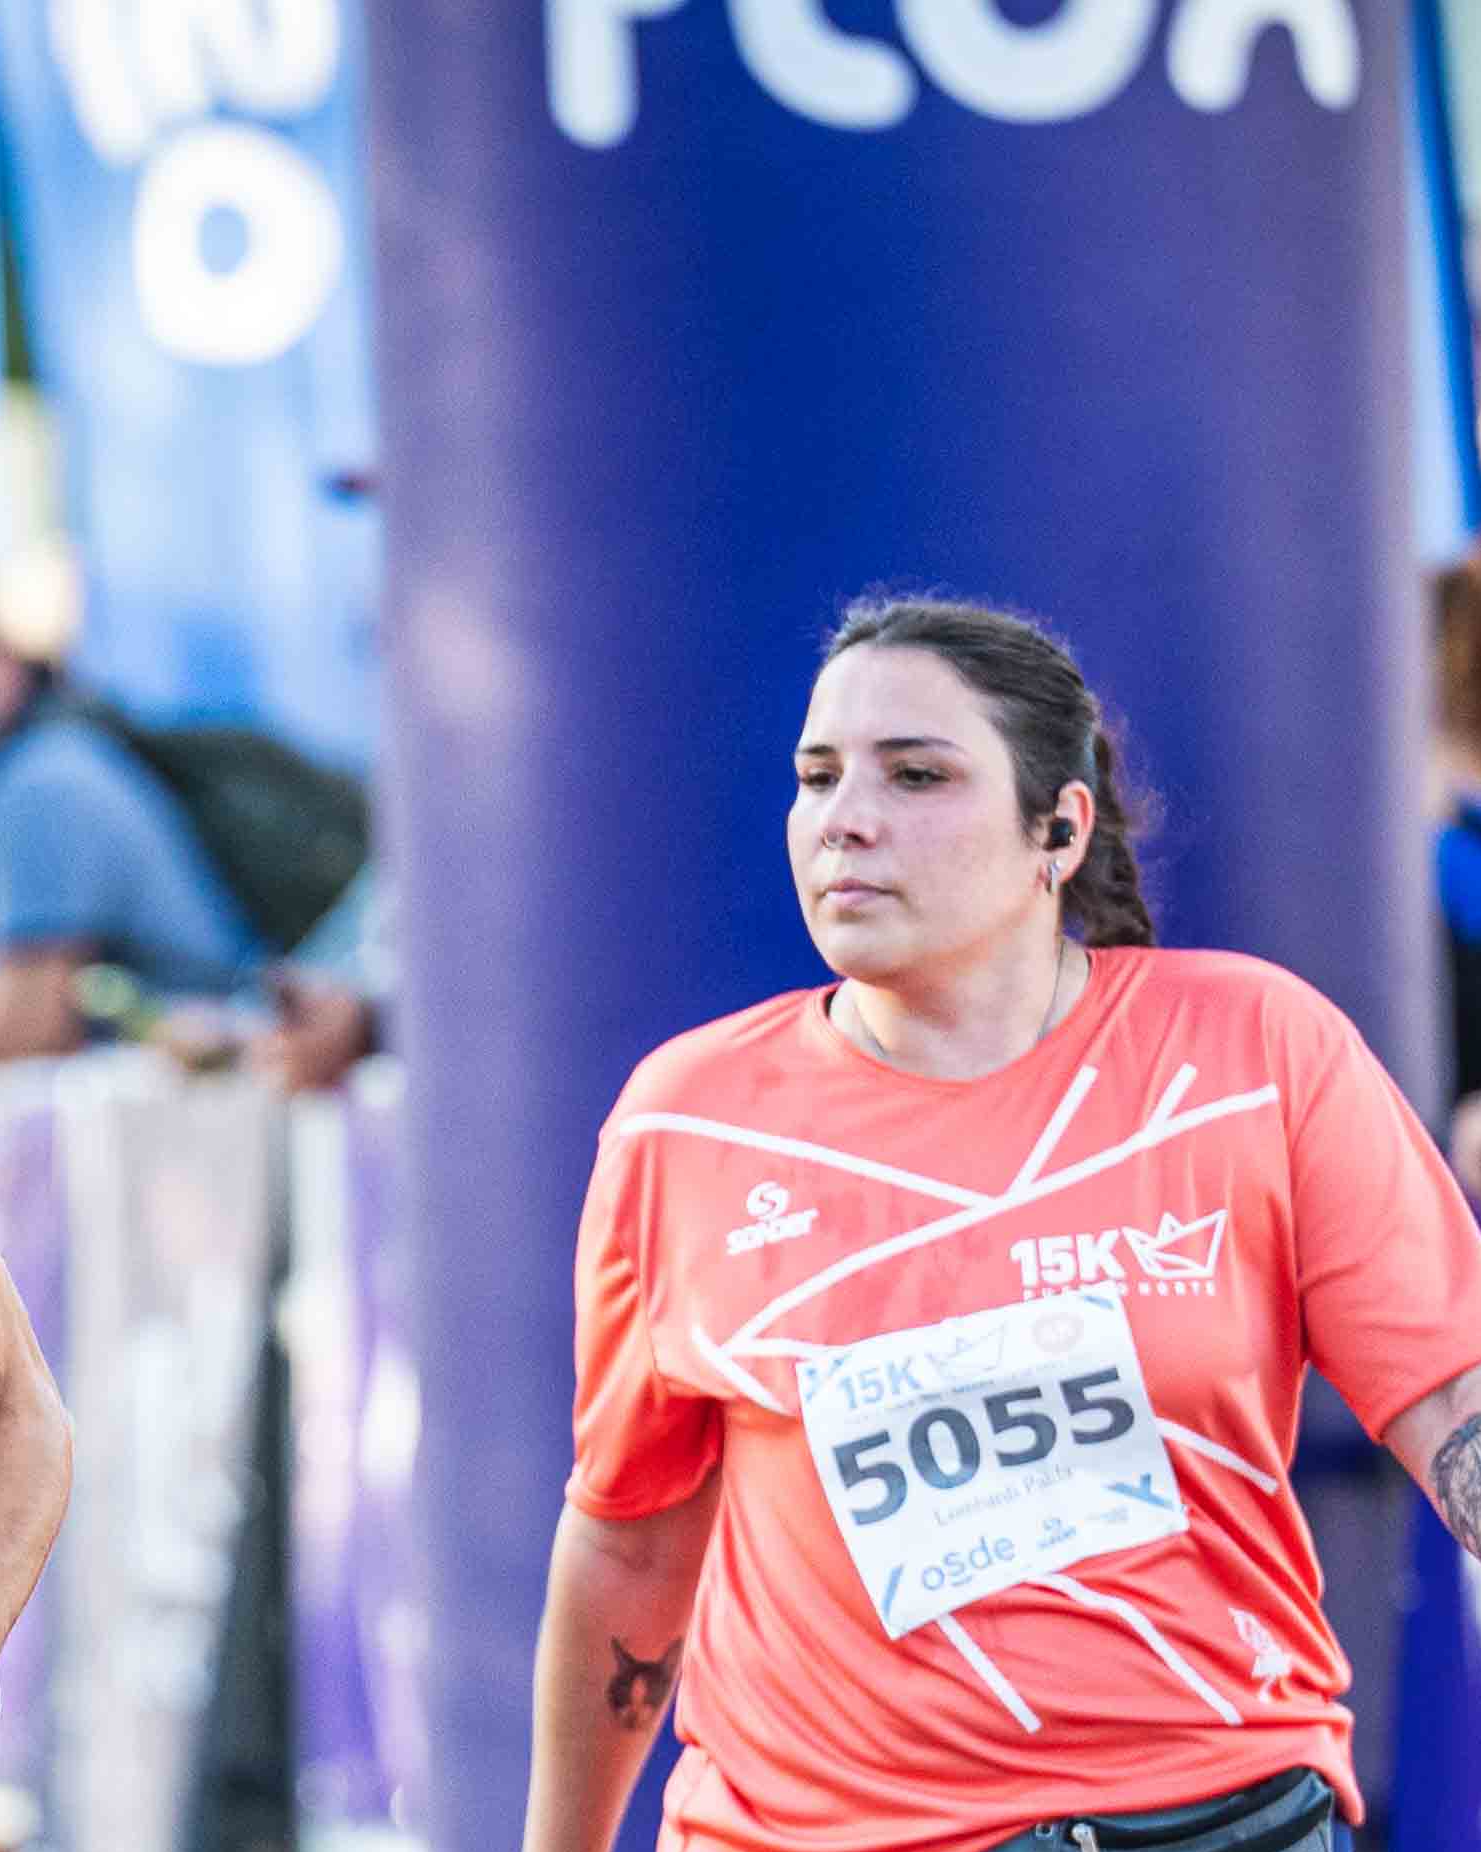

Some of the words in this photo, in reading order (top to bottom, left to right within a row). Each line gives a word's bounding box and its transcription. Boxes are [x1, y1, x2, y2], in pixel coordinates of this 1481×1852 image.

[1010, 1228, 1126, 1286] 15K
[839, 1357, 921, 1410] 15K
[831, 1366, 1135, 1527] 5055
[922, 1535, 1016, 1591] osde
